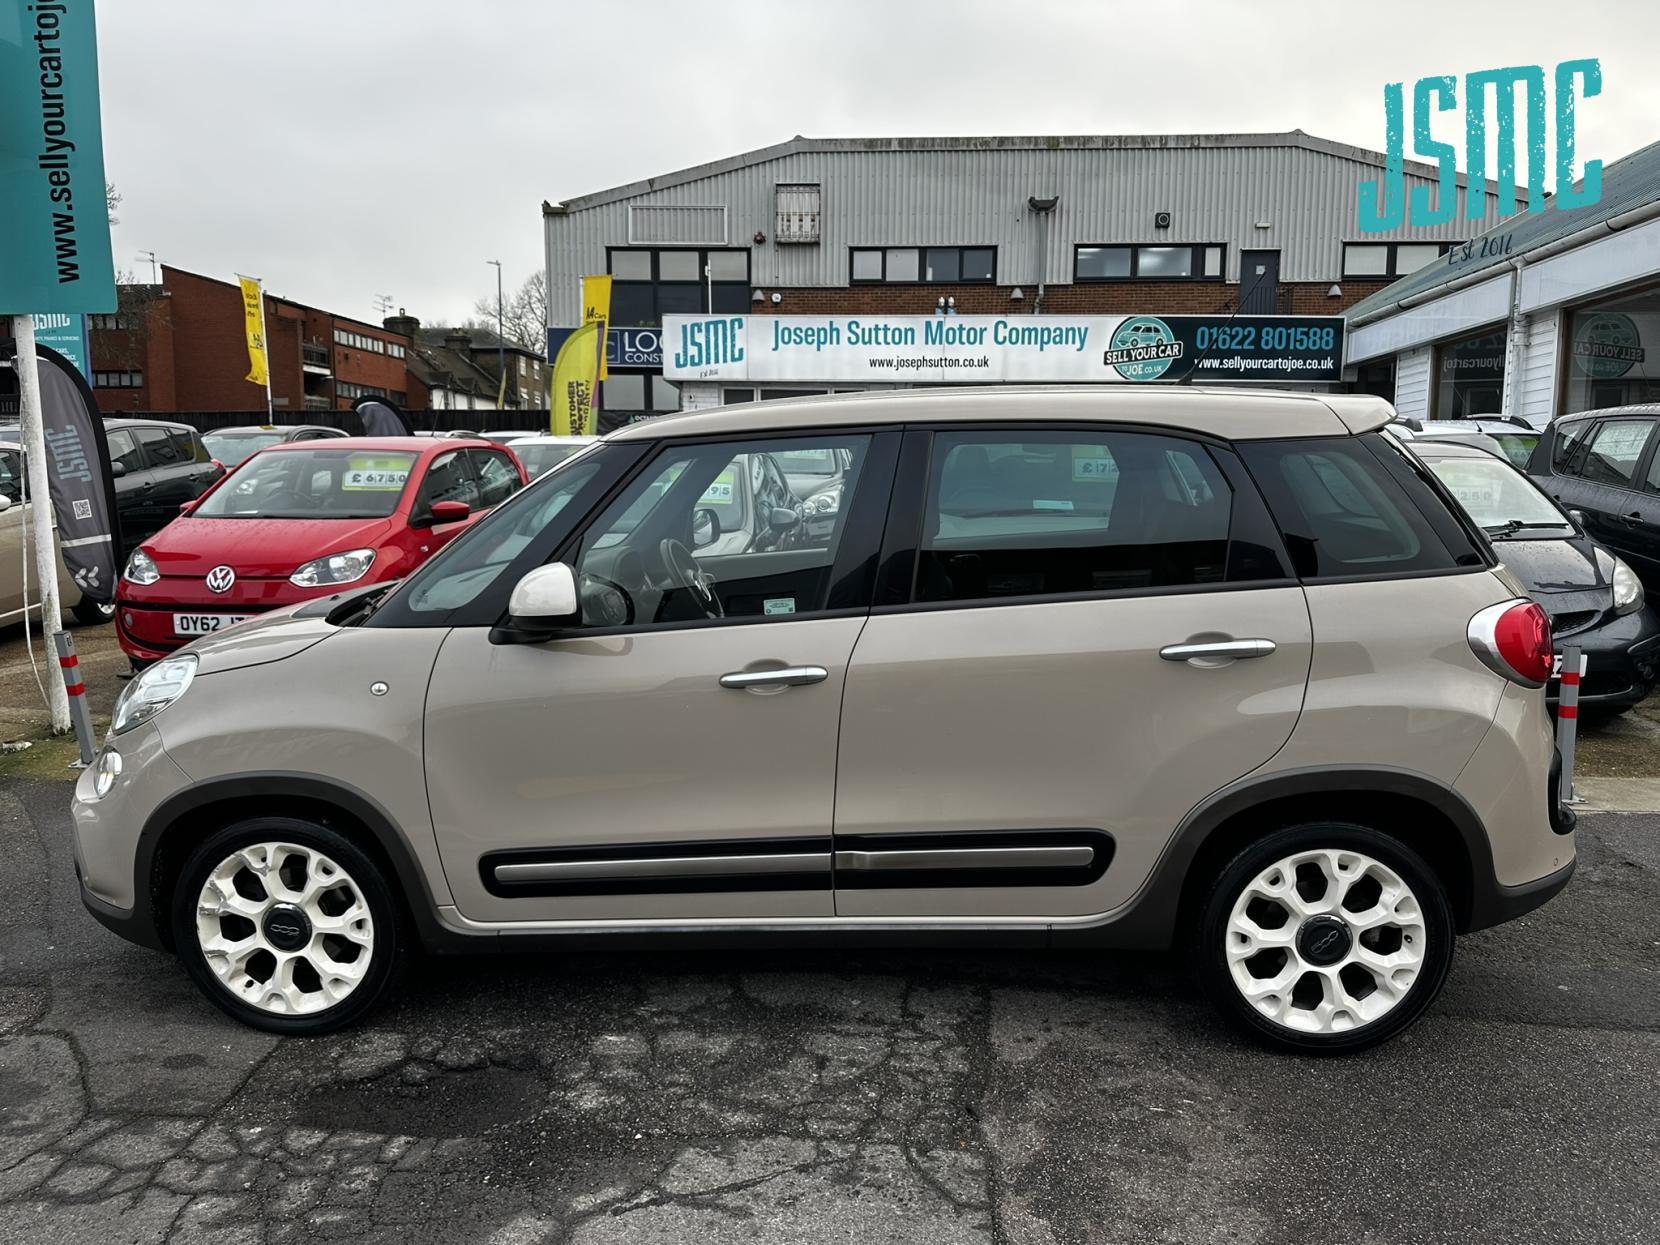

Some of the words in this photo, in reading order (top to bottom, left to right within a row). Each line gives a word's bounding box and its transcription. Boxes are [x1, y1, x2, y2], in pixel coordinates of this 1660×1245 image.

[675, 318, 744, 369] JSMC
[772, 320, 841, 352] Joseph
[847, 320, 915, 346] Sutton
[924, 320, 987, 346] Motor
[993, 320, 1089, 352] Company
[1196, 326, 1255, 350] 01622
[1261, 327, 1334, 351] 801588
[869, 355, 990, 371] www.josephsutton.co.uk
[1106, 351, 1129, 364] SELL
[1130, 346, 1158, 361] YOUR
[1158, 344, 1180, 358] CAR
[45, 424, 93, 483] JSMC
